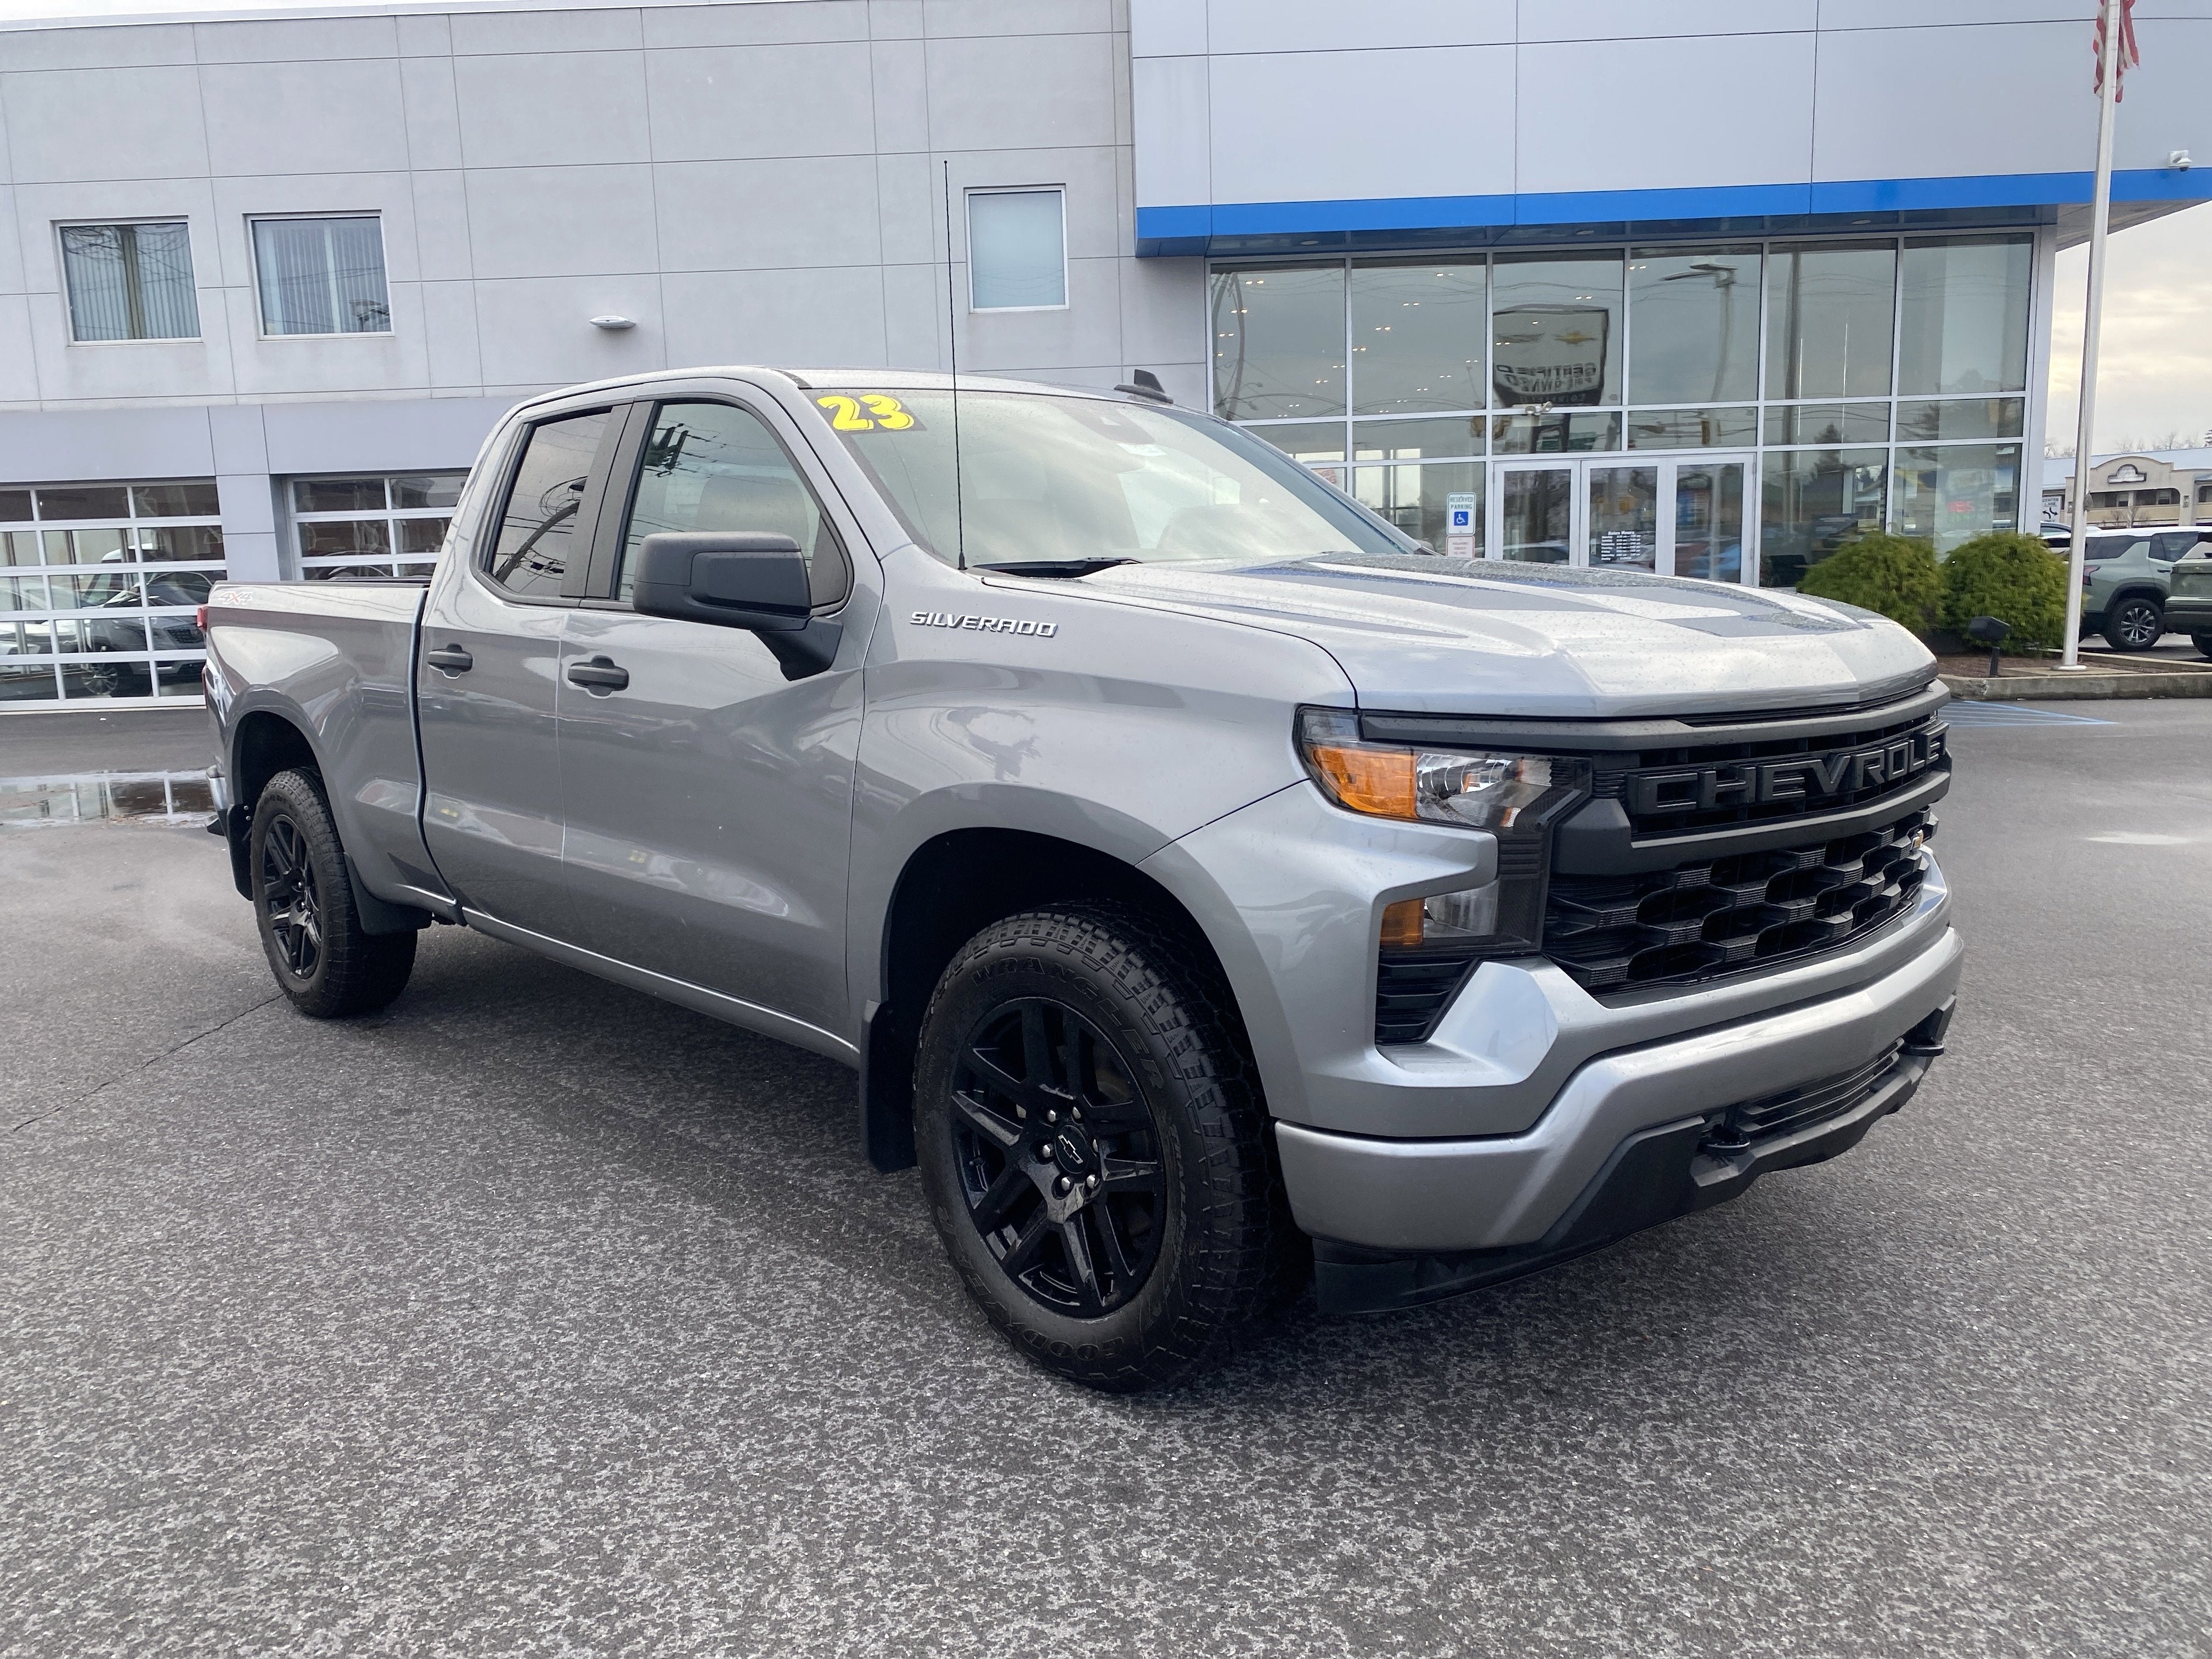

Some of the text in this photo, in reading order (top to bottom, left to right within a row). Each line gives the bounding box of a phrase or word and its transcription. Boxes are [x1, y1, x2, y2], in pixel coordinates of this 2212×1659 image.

[816, 394, 915, 431] 23
[910, 611, 1058, 637] SILVERADO
[970, 956, 1164, 1090] WRANGLER
